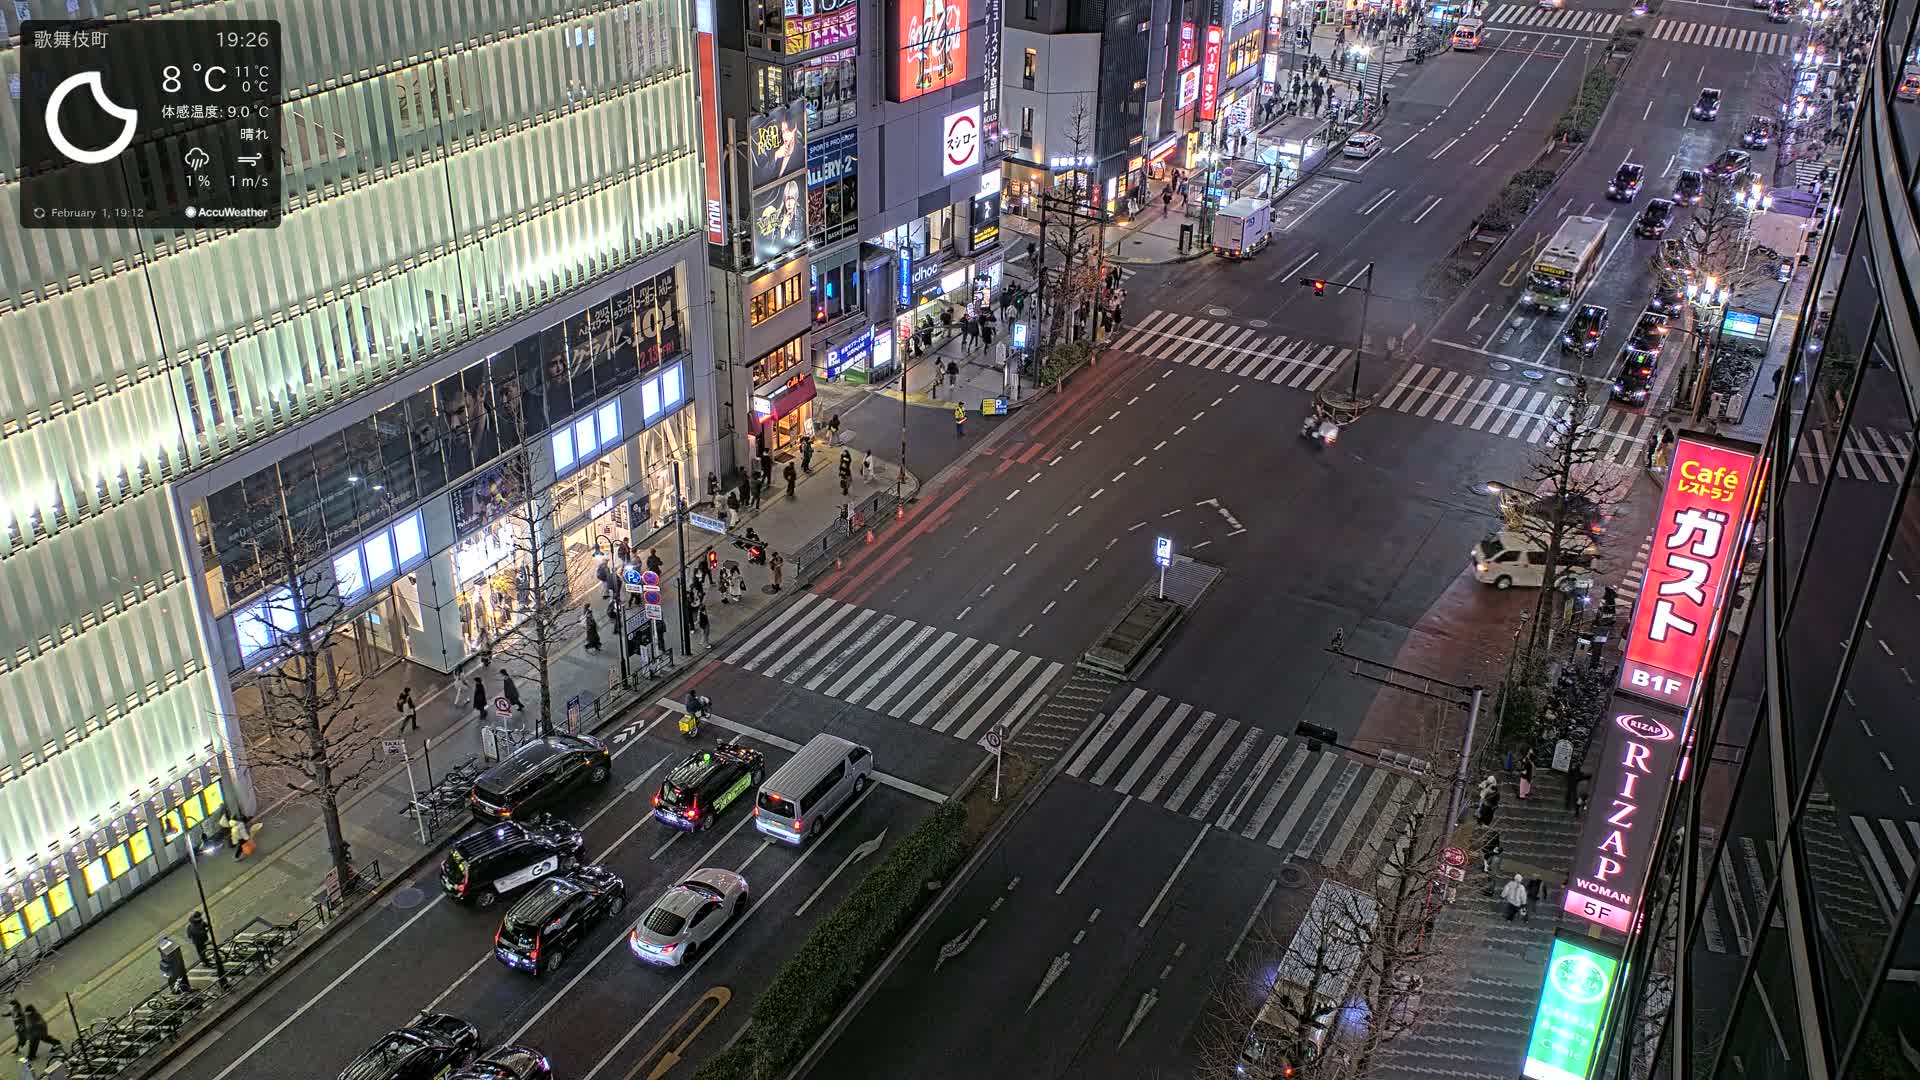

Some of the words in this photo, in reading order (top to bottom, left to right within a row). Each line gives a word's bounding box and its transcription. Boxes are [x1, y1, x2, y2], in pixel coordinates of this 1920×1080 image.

[1204, 45, 1219, 111] バーガーキング
[947, 133, 978, 151] スシロー
[708, 199, 722, 233] MUJI
[594, 306, 610, 320] クリス
[617, 295, 632, 308] マーク
[631, 300, 675, 347] 101
[1681, 460, 1740, 490] Café
[1678, 479, 1735, 502] レストラン
[1160, 539, 1168, 549] P
[1649, 508, 1727, 642] ガスト
[1631, 669, 1682, 695] B1F
[1630, 719, 1661, 735] RIZAP
[1594, 741, 1652, 882] RIZAP
[532, 861, 552, 876] GO
[1576, 878, 1631, 905] WOMAN
[1584, 901, 1612, 919] 5F
